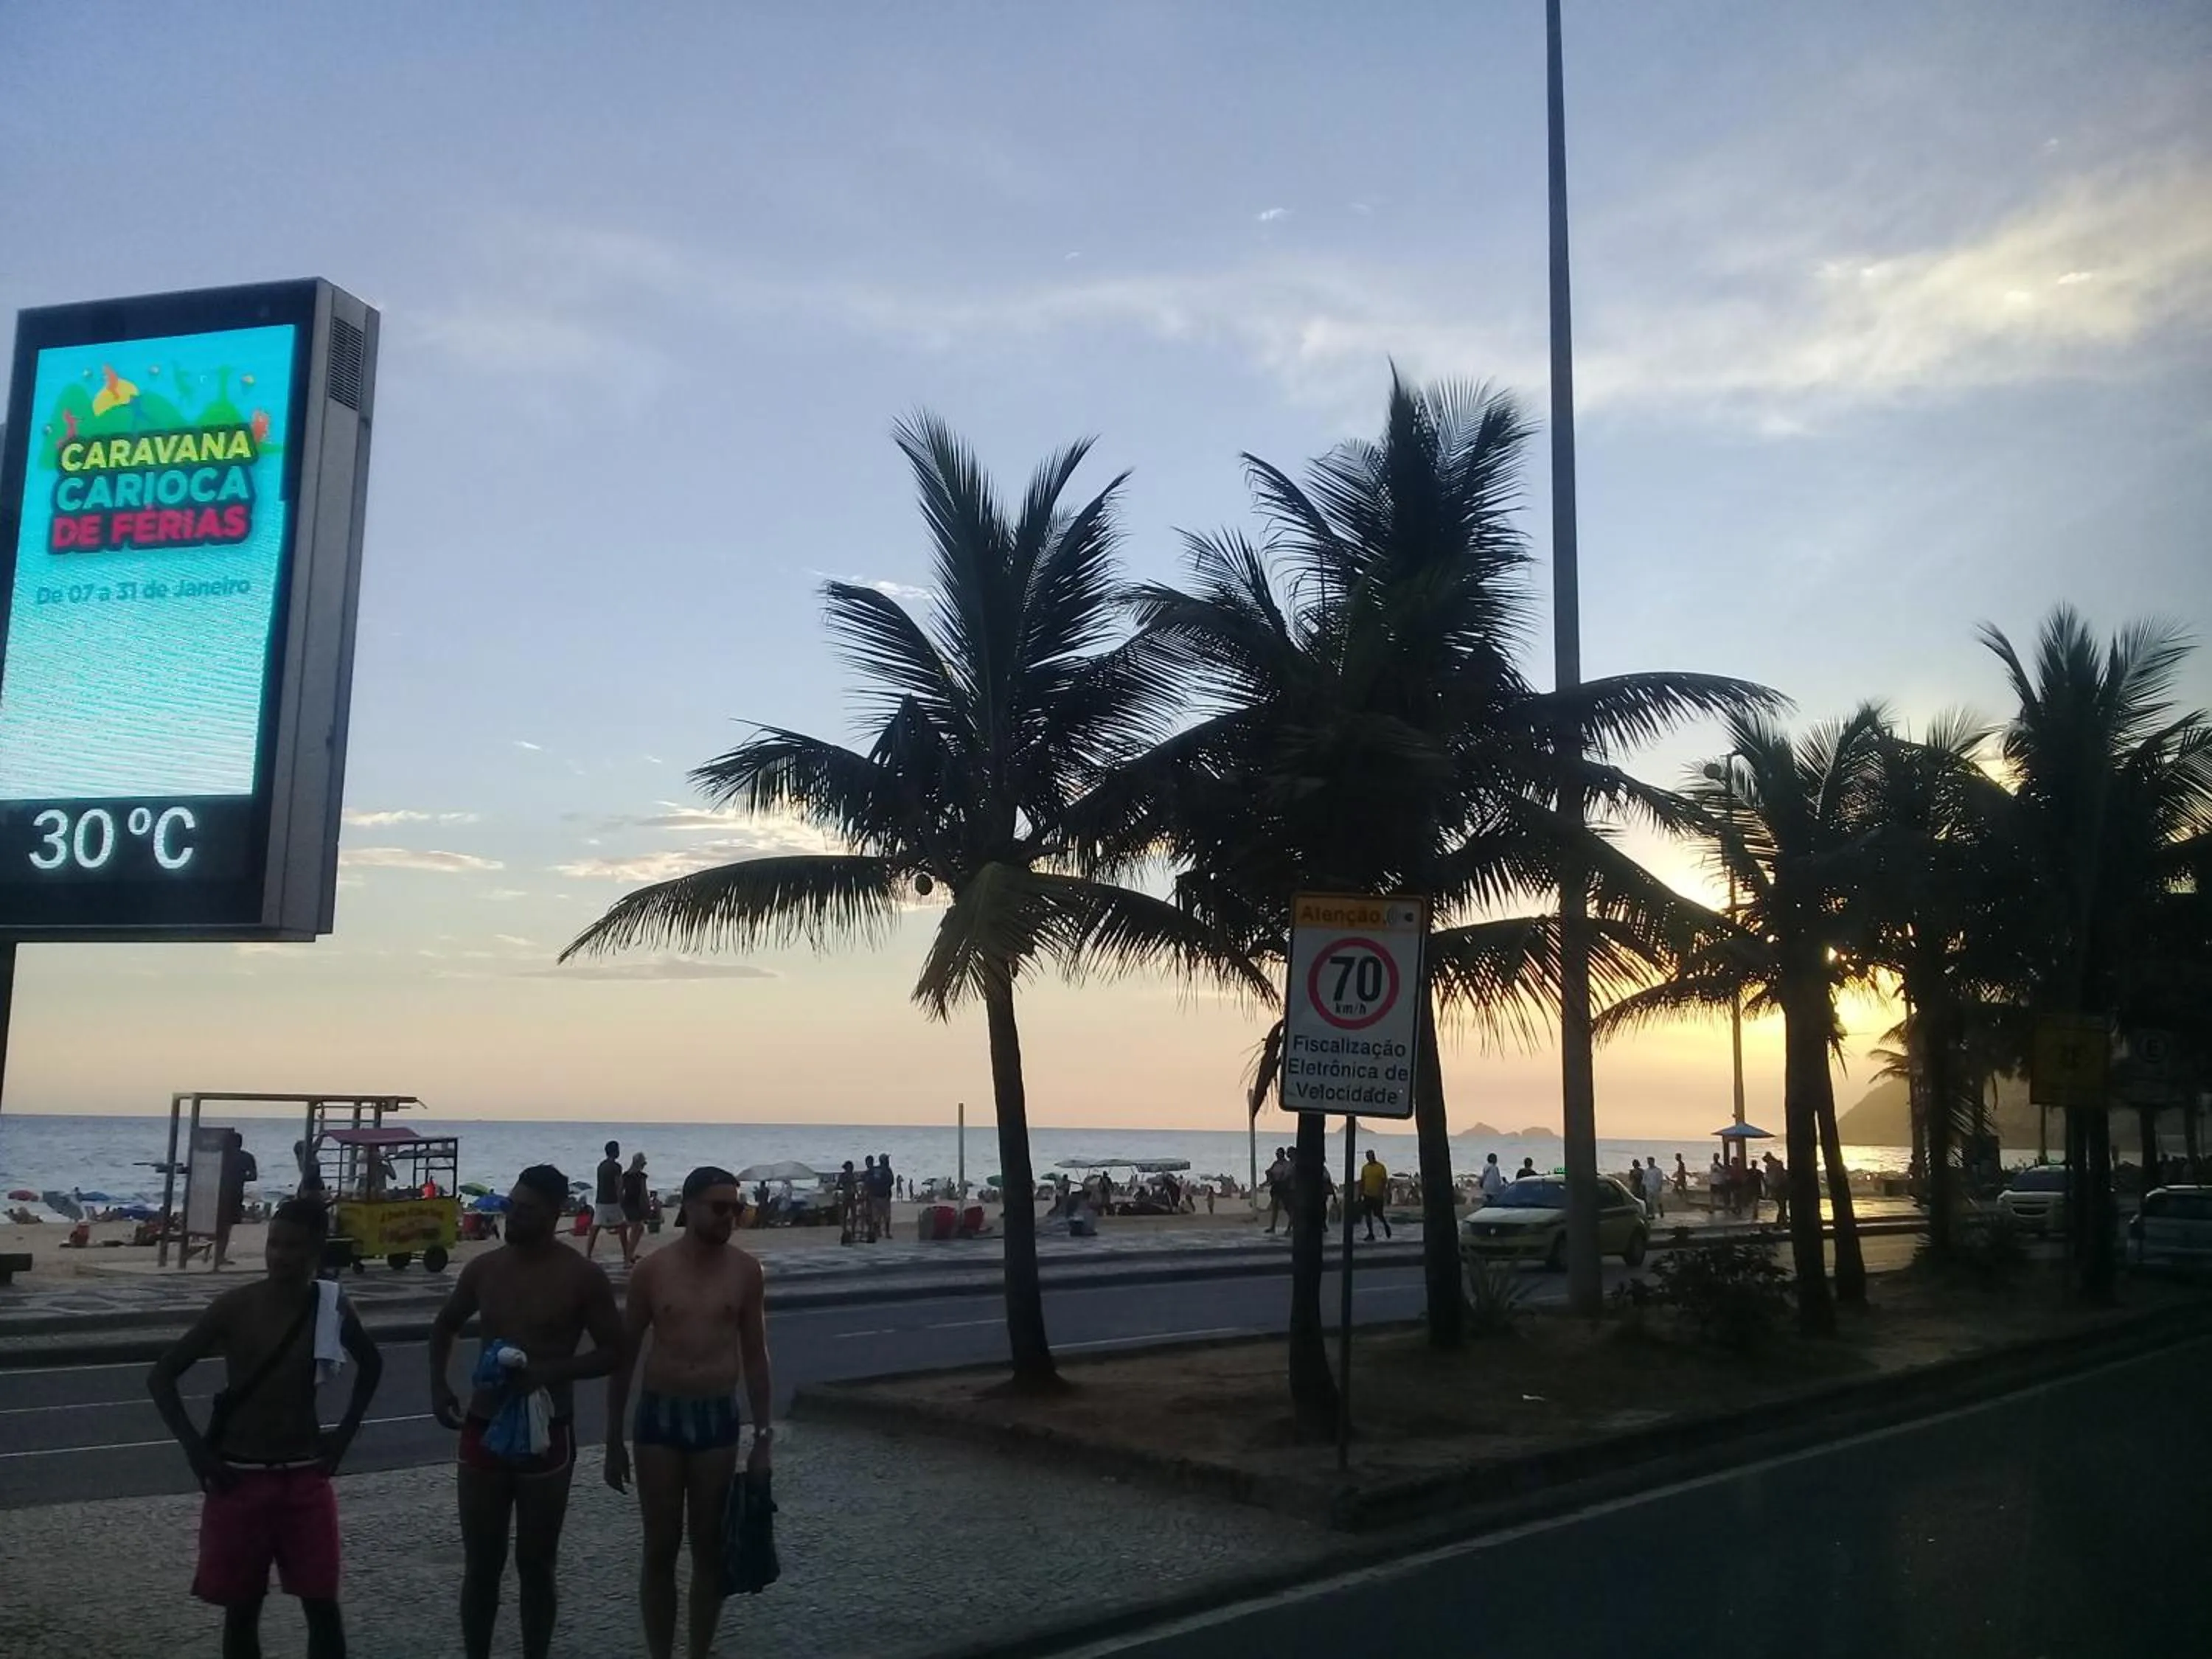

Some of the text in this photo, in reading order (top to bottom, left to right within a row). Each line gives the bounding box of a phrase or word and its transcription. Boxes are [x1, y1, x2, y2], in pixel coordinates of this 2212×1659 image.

[60, 430, 251, 472] CARAVANA
[56, 465, 248, 511] CARIOCA
[52, 515, 101, 548] DE
[37, 585, 63, 605] De
[68, 583, 94, 603] 07
[98, 588, 110, 601] a
[116, 581, 137, 600] 31
[142, 580, 168, 599] de
[29, 808, 114, 869] 30
[1329, 956, 1383, 1002] 70
[1335, 1002, 1367, 1015] km/h
[1293, 1034, 1407, 1059] Fiscalização
[1287, 1058, 1409, 1082] Eletrônica de
[1295, 1082, 1399, 1105] Velocidade
